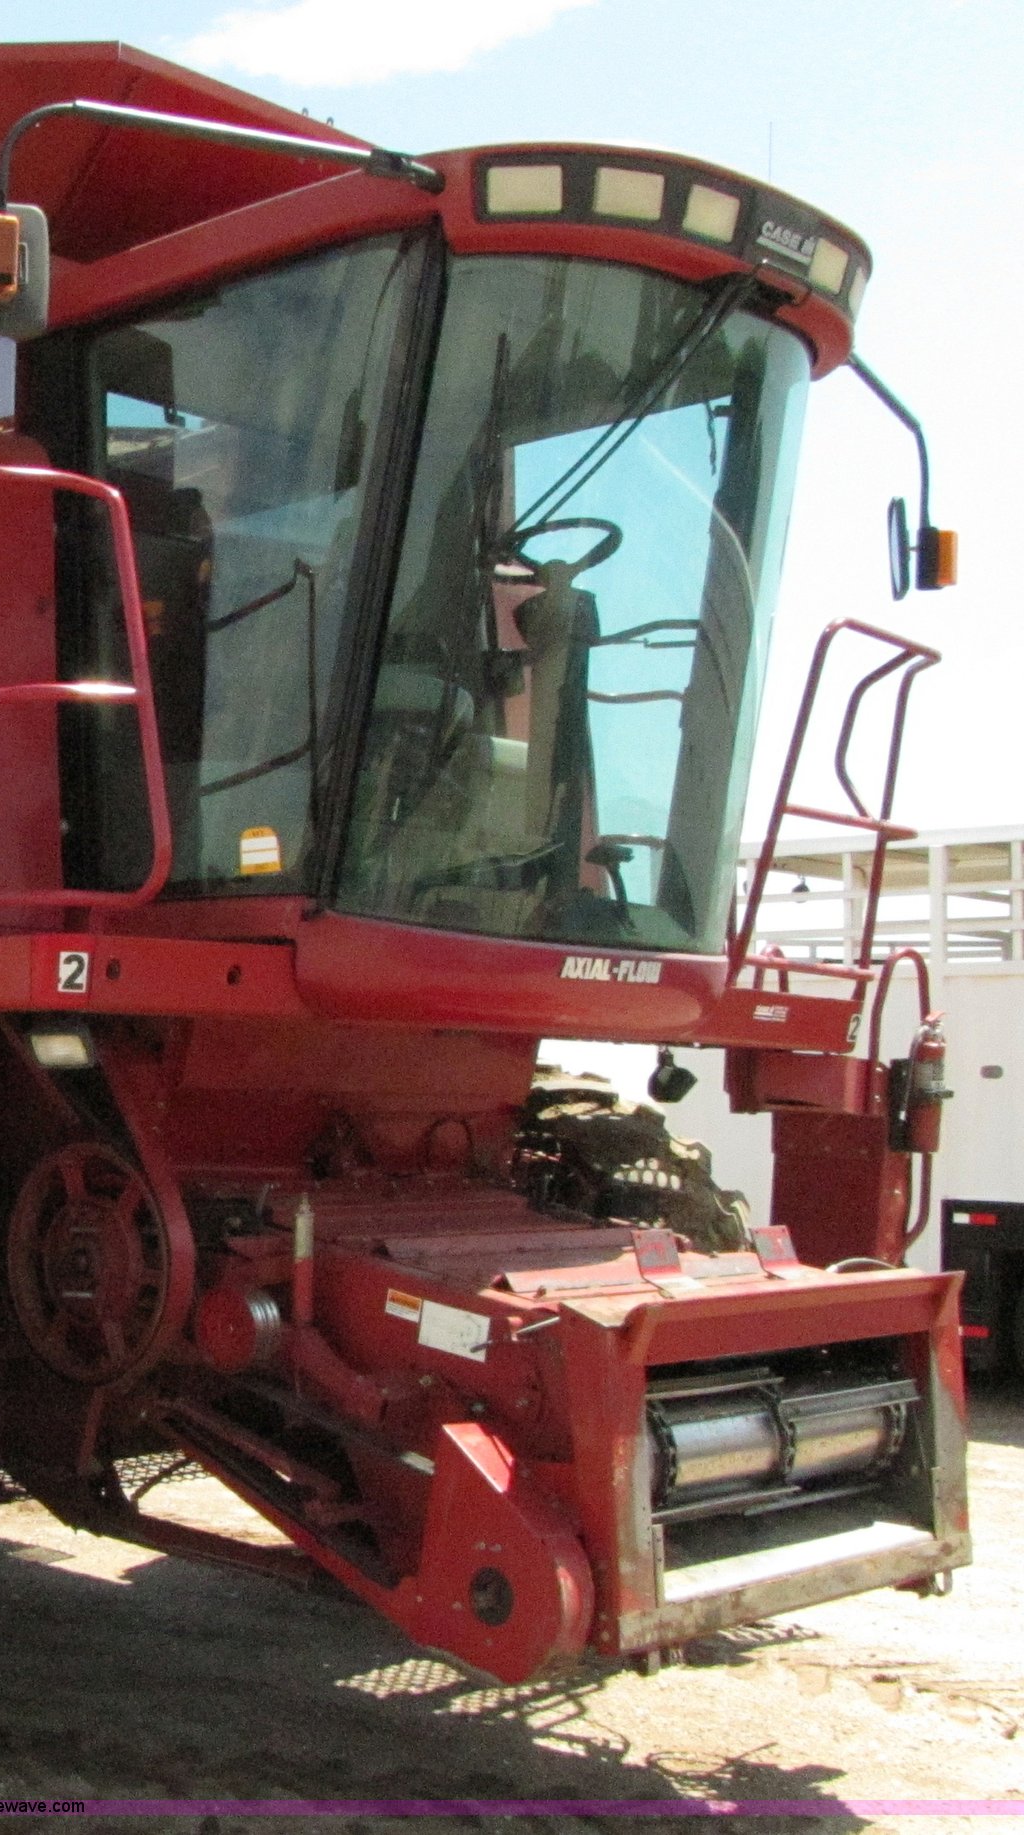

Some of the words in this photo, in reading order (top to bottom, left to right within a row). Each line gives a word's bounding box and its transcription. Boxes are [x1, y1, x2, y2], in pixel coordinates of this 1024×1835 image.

[761, 220, 802, 250] CASE
[61, 953, 86, 990] 2
[560, 956, 662, 984] AXIAL-FLOW
[848, 1014, 861, 1041] 2
